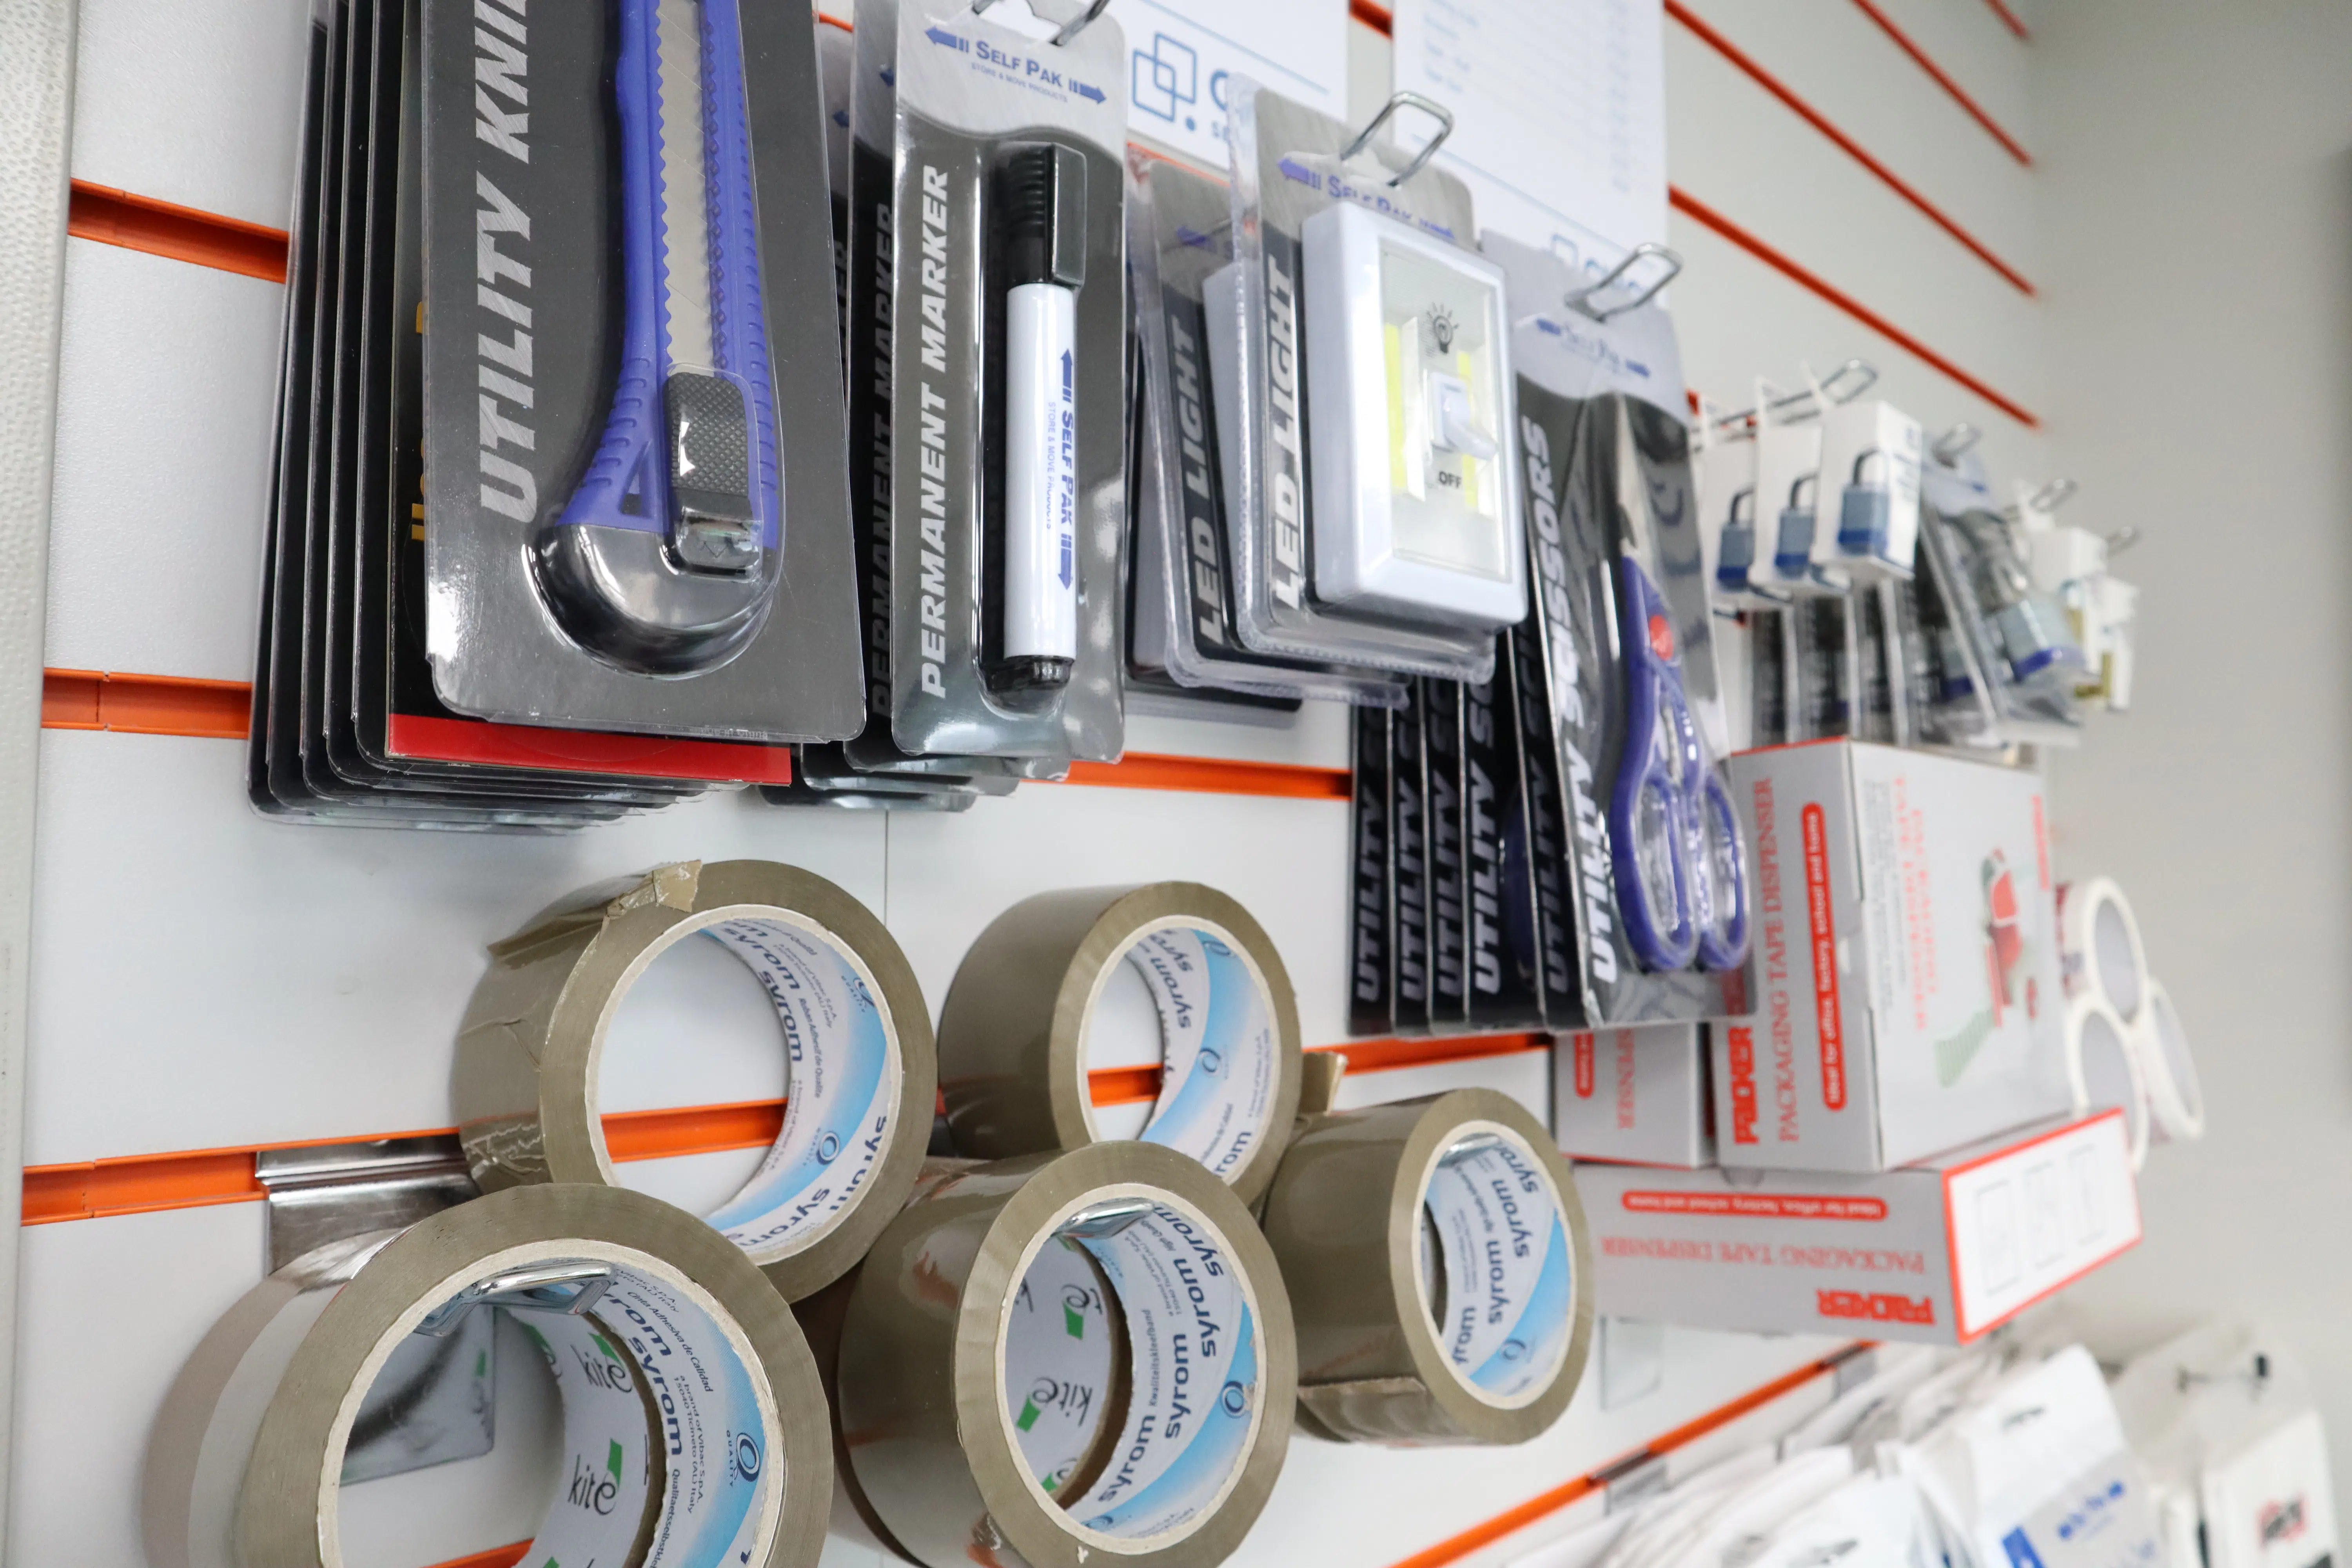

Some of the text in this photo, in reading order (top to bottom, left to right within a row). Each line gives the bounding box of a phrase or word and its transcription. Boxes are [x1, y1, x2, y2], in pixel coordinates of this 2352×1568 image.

[976, 40, 1063, 87] SELF PAK
[476, 170, 538, 524] UTILITY
[921, 165, 949, 699] PERMANENT MARKER
[1047, 445, 1056, 473] MOVE
[1060, 410, 1074, 525] SELF PAK
[1267, 253, 1301, 611] LED LIGHT
[1171, 316, 1224, 645] LED LIGHT
[1439, 471, 1462, 488] OFF
[1357, 783, 1384, 1003] UTILITY
[1398, 777, 1425, 1002] UTILITY
[1432, 769, 1462, 998] UTILITY
[1470, 758, 1501, 996] UTILITY
[1529, 753, 1567, 995] UTILITY
[1565, 738, 1616, 984] UTILITY
[1151, 956, 1193, 1029] syrom
[1764, 919, 1788, 985] TAPE
[759, 970, 803, 1062] syrom
[1215, 1130, 1252, 1173] rom
[1498, 1147, 1539, 1193] syro
[1153, 1206, 1224, 1277] syrom
[1492, 1180, 1533, 1258] syrom
[604, 1281, 671, 1356] rom
[1173, 1258, 1220, 1357] syrom
[1486, 1239, 1511, 1325] syrom
[570, 1344, 633, 1393] kite
[628, 1292, 714, 1392] Cinta Adhesiva de Calidad
[628, 1337, 682, 1455] syrom
[684, 1383, 699, 1417] brand
[1031, 1377, 1093, 1427] kite
[1165, 1334, 1191, 1439] syrom
[568, 1454, 617, 1515] kite
[687, 1488, 696, 1514] Italy
[1098, 1415, 1156, 1502] syrom
